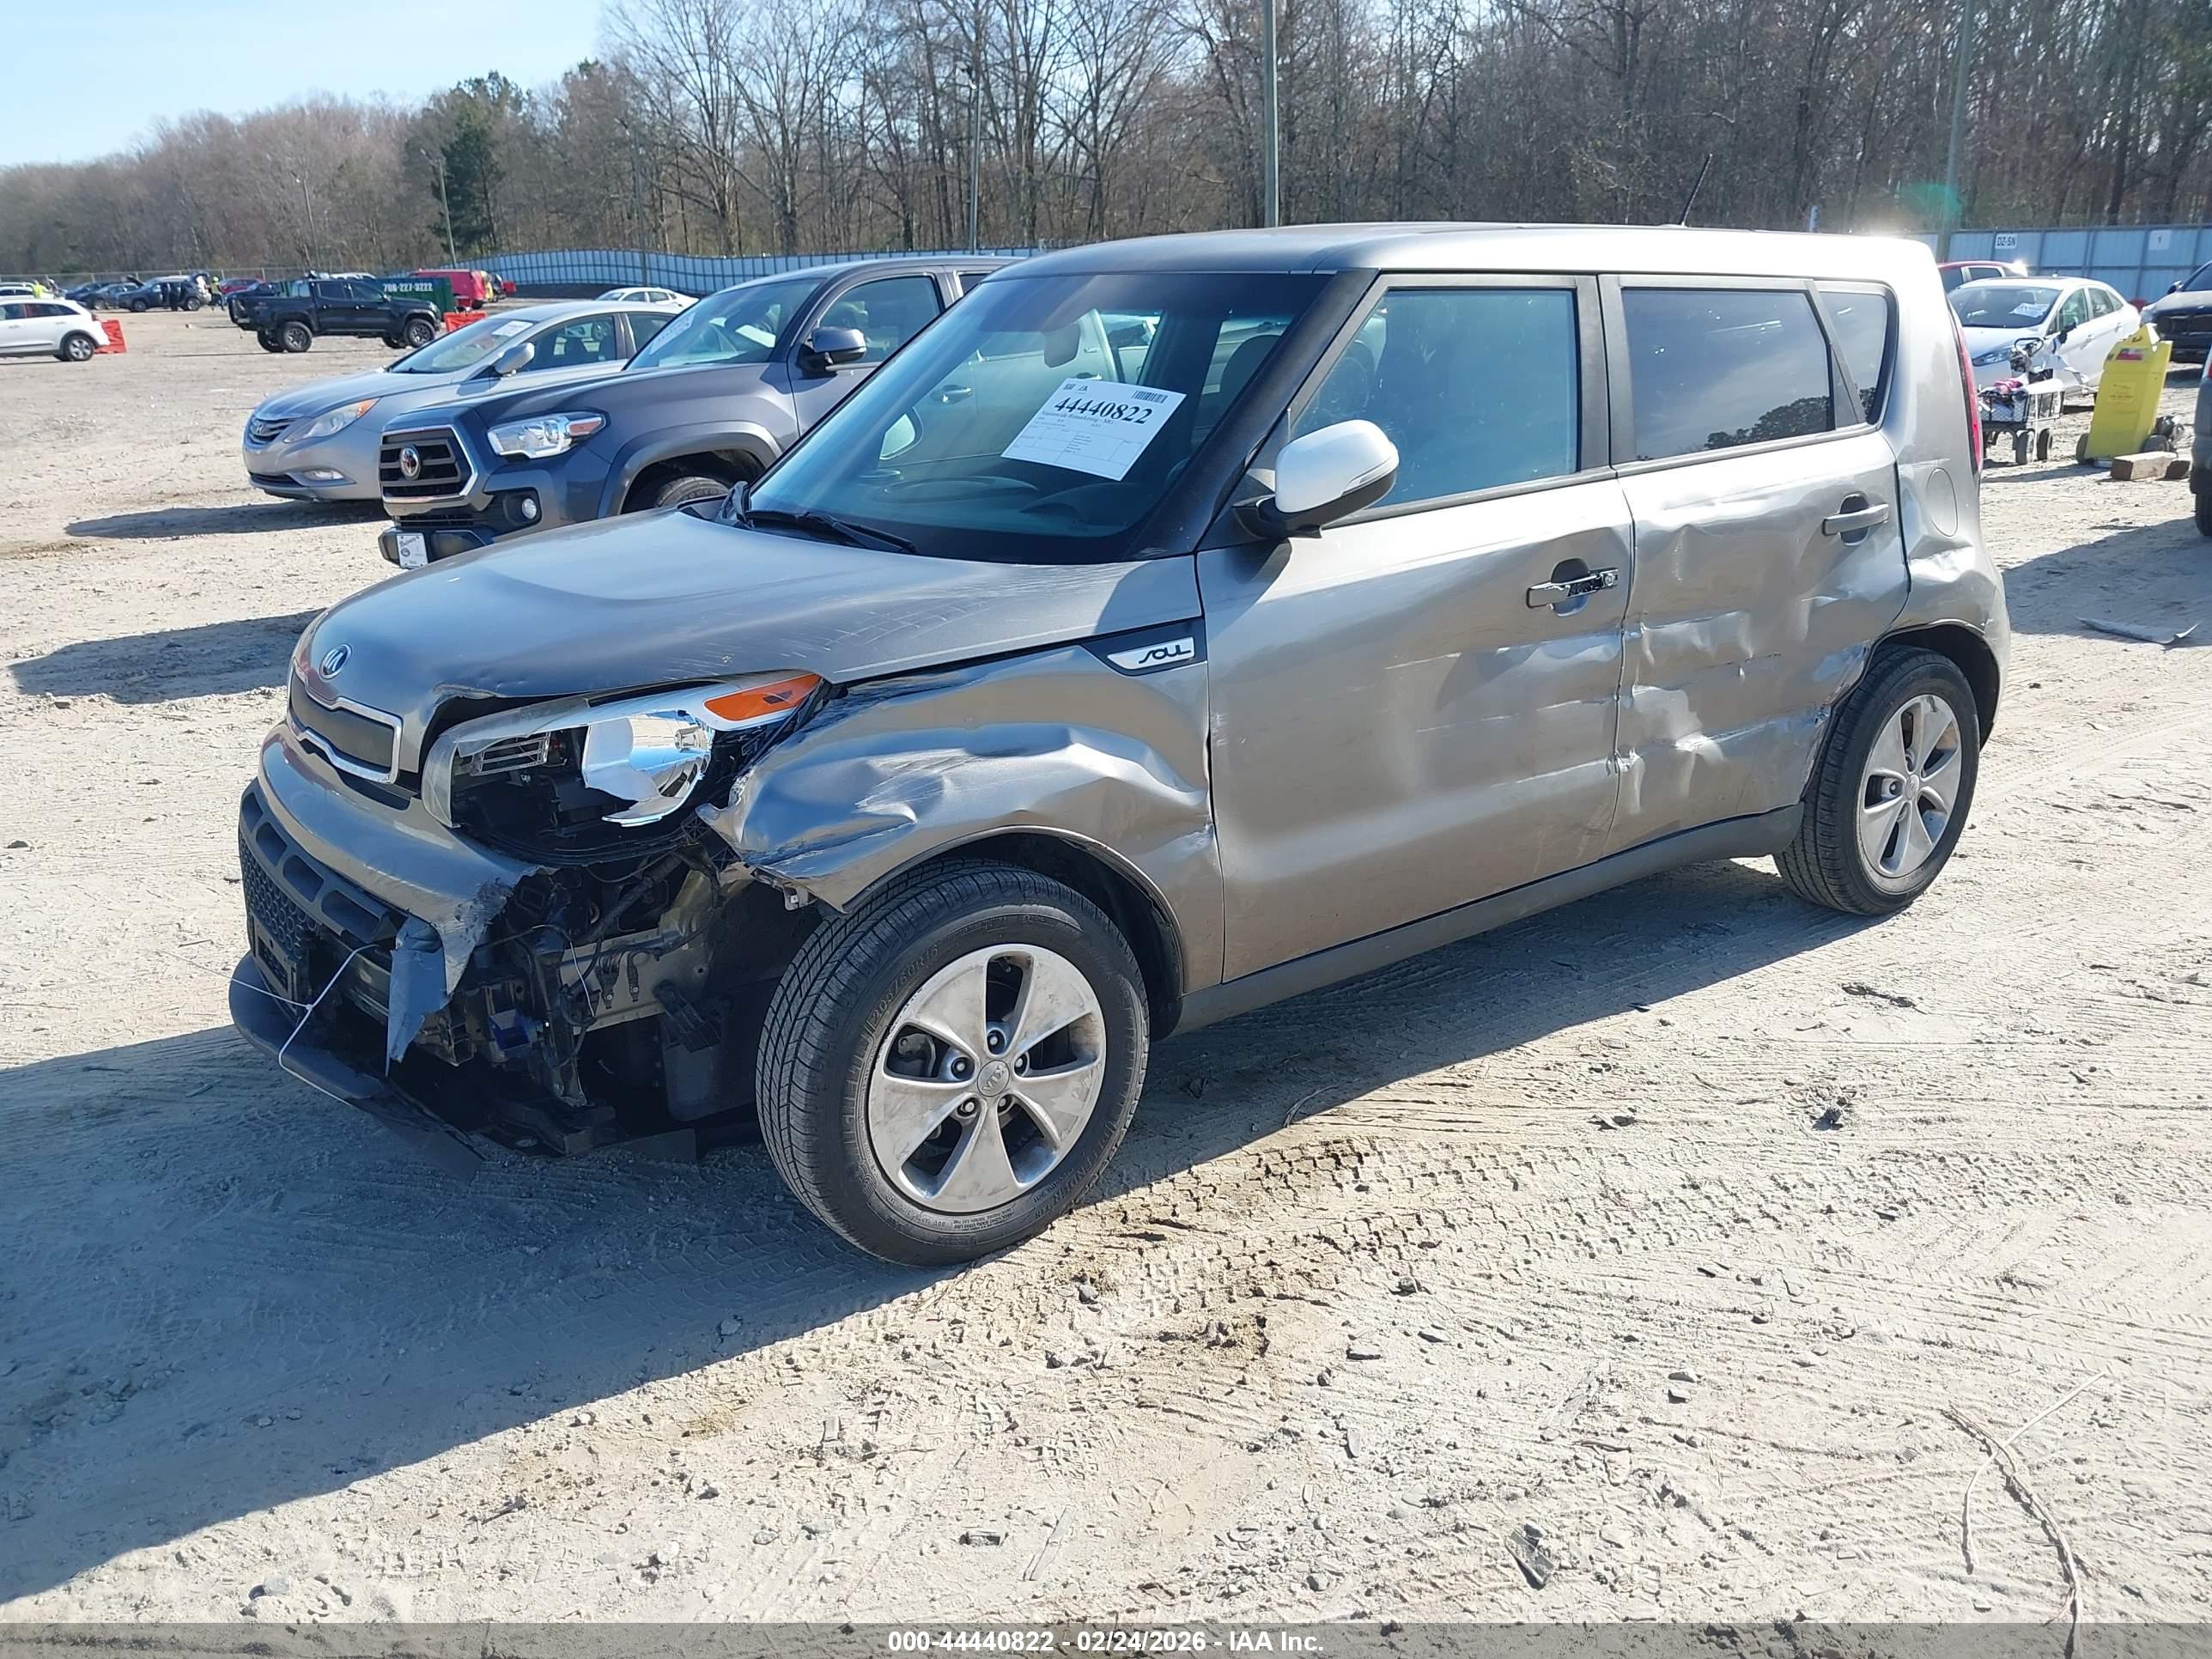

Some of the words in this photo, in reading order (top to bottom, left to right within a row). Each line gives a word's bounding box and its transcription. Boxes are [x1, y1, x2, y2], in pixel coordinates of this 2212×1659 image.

[1054, 398, 1152, 424] 44440822
[1138, 645, 1191, 664] SOUL
[981, 1063, 1007, 1091] KIA
